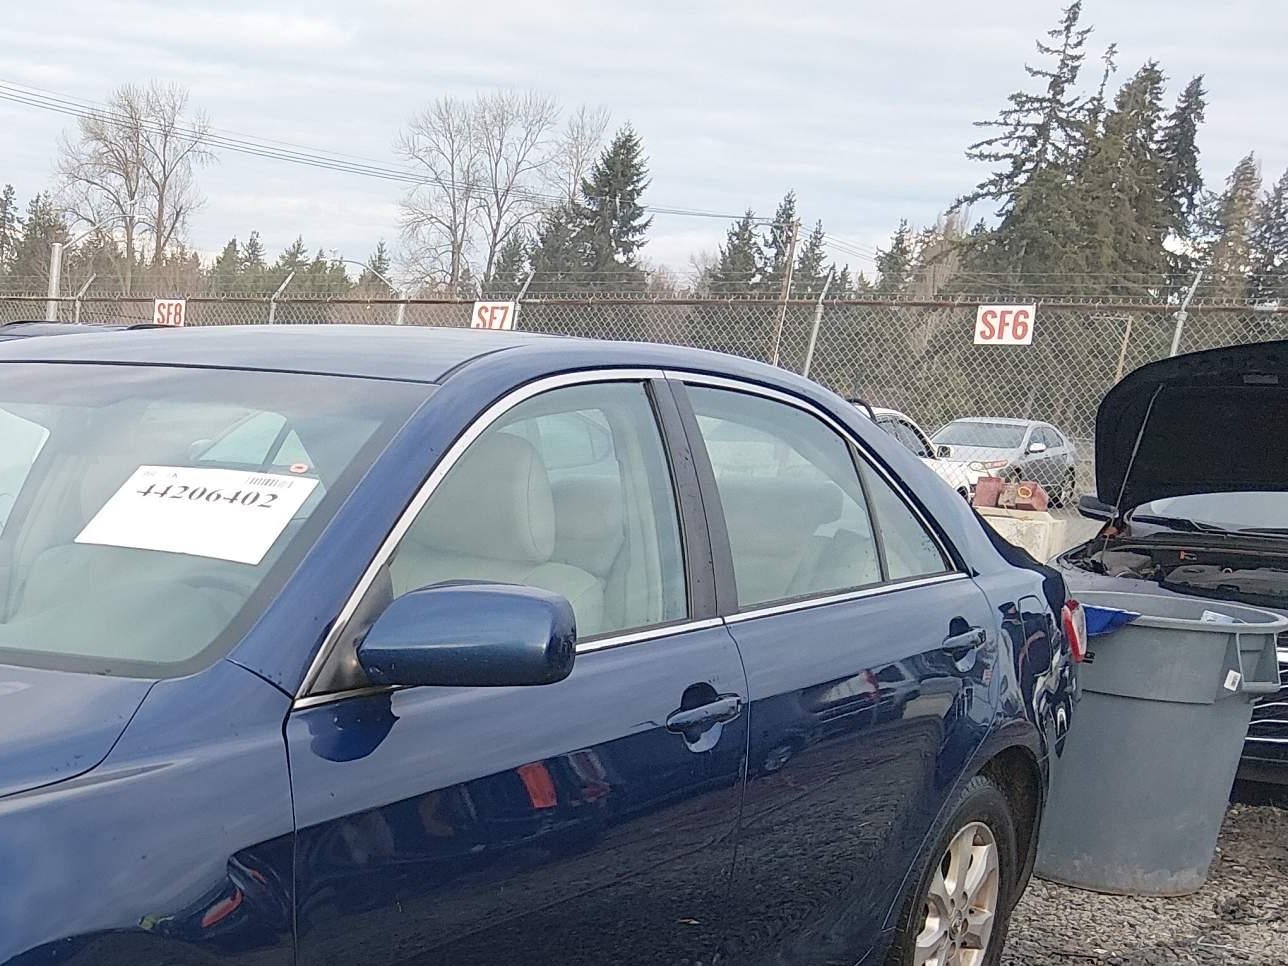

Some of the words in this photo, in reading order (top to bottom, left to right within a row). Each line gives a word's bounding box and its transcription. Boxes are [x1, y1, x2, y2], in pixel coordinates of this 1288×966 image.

[157, 302, 183, 325] SF8
[475, 305, 509, 329] SF7
[979, 309, 1030, 341] SF6
[136, 483, 279, 509] 44206402
